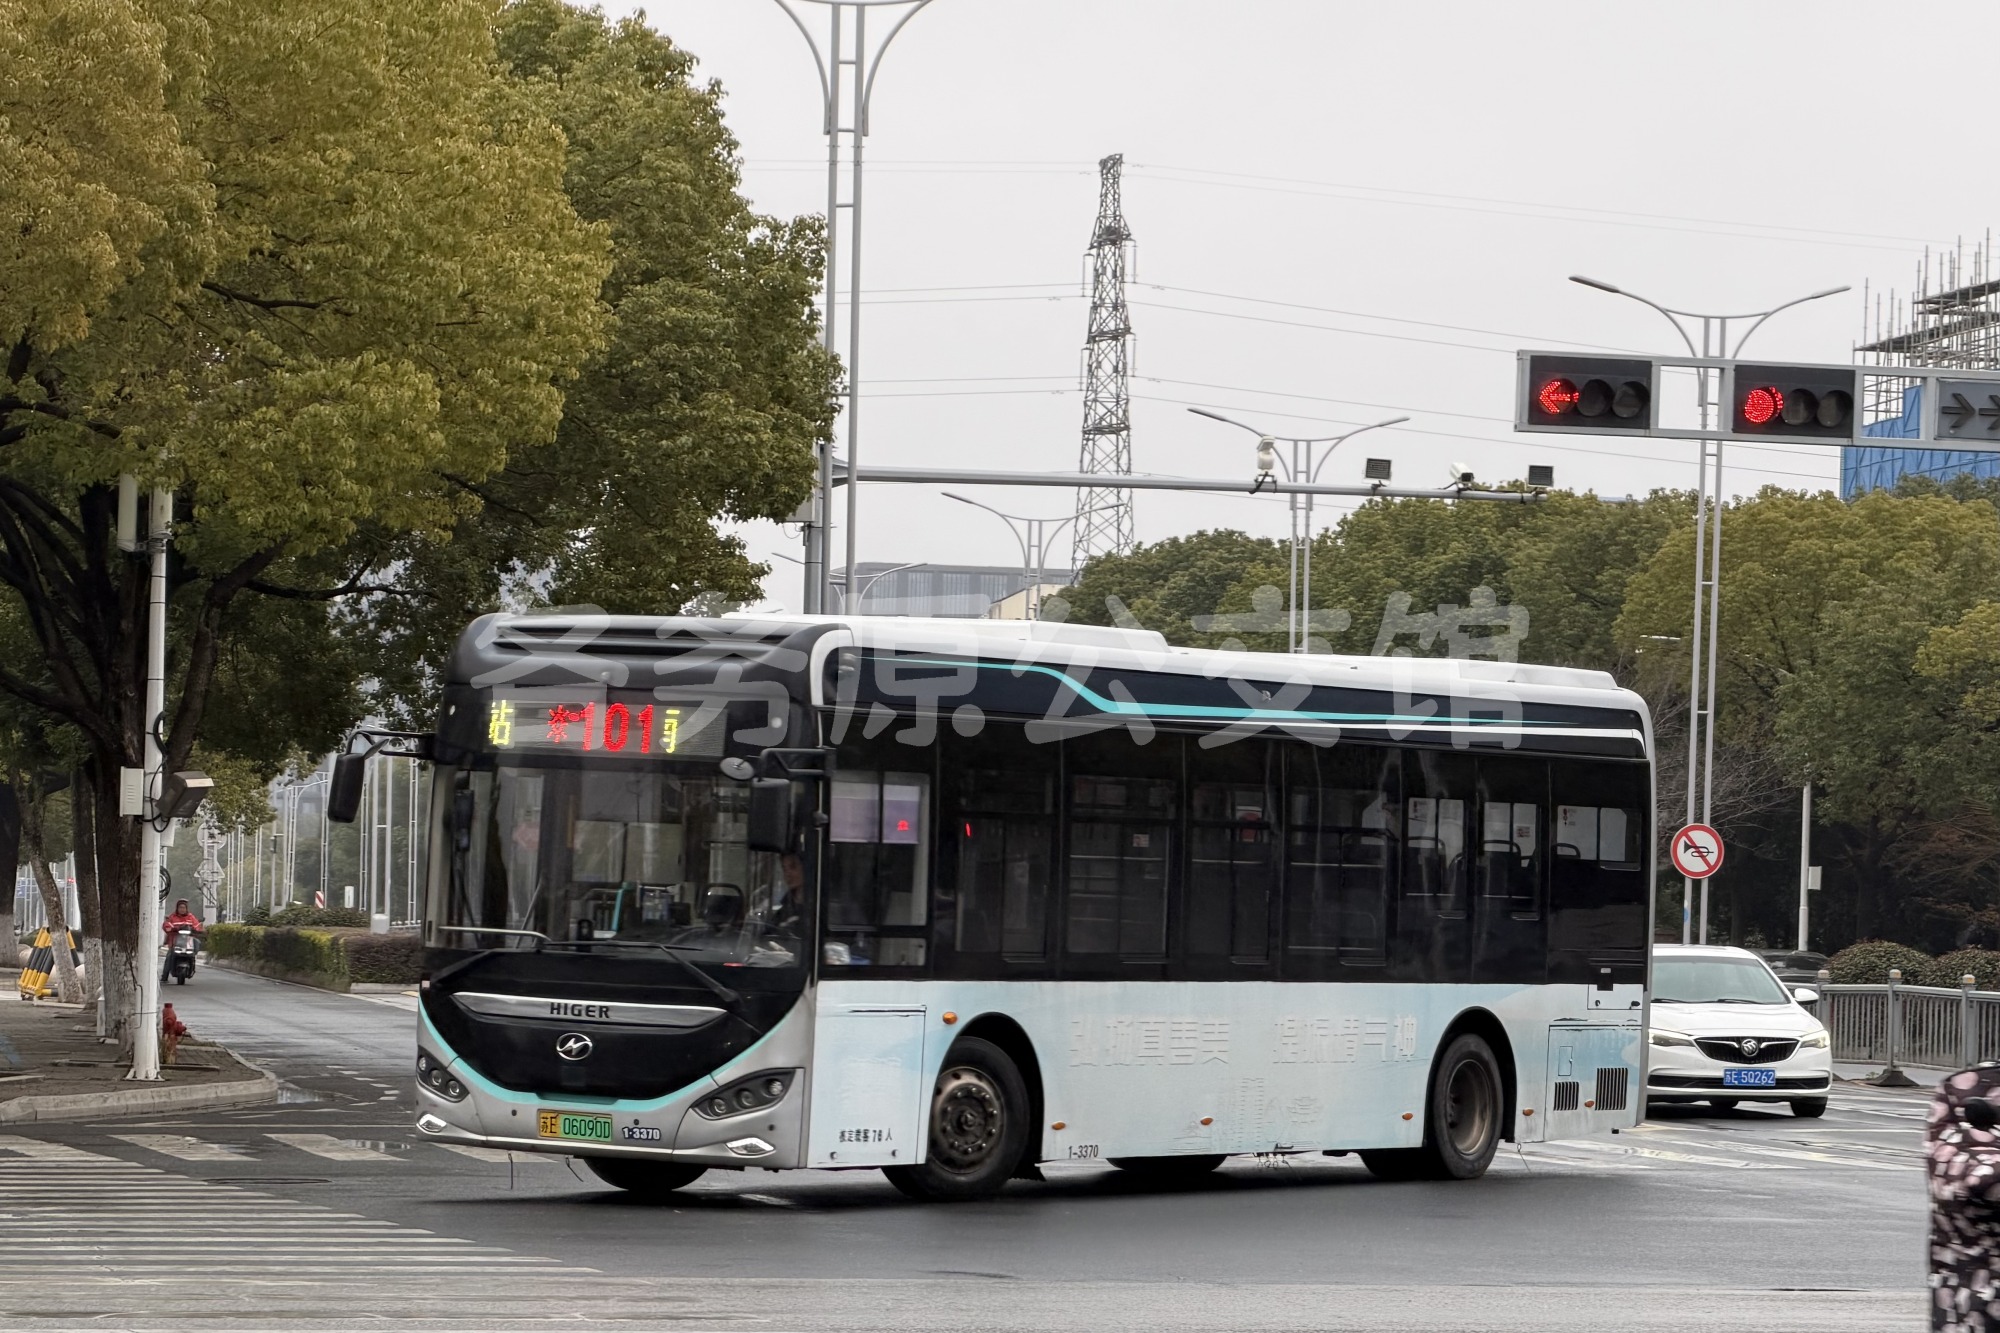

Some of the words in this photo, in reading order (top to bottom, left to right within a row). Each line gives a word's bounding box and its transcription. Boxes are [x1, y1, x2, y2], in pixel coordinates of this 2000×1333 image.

[580, 702, 654, 753] 101
[550, 1002, 610, 1019] HIGER
[1068, 1144, 1099, 1159] 1-3370
